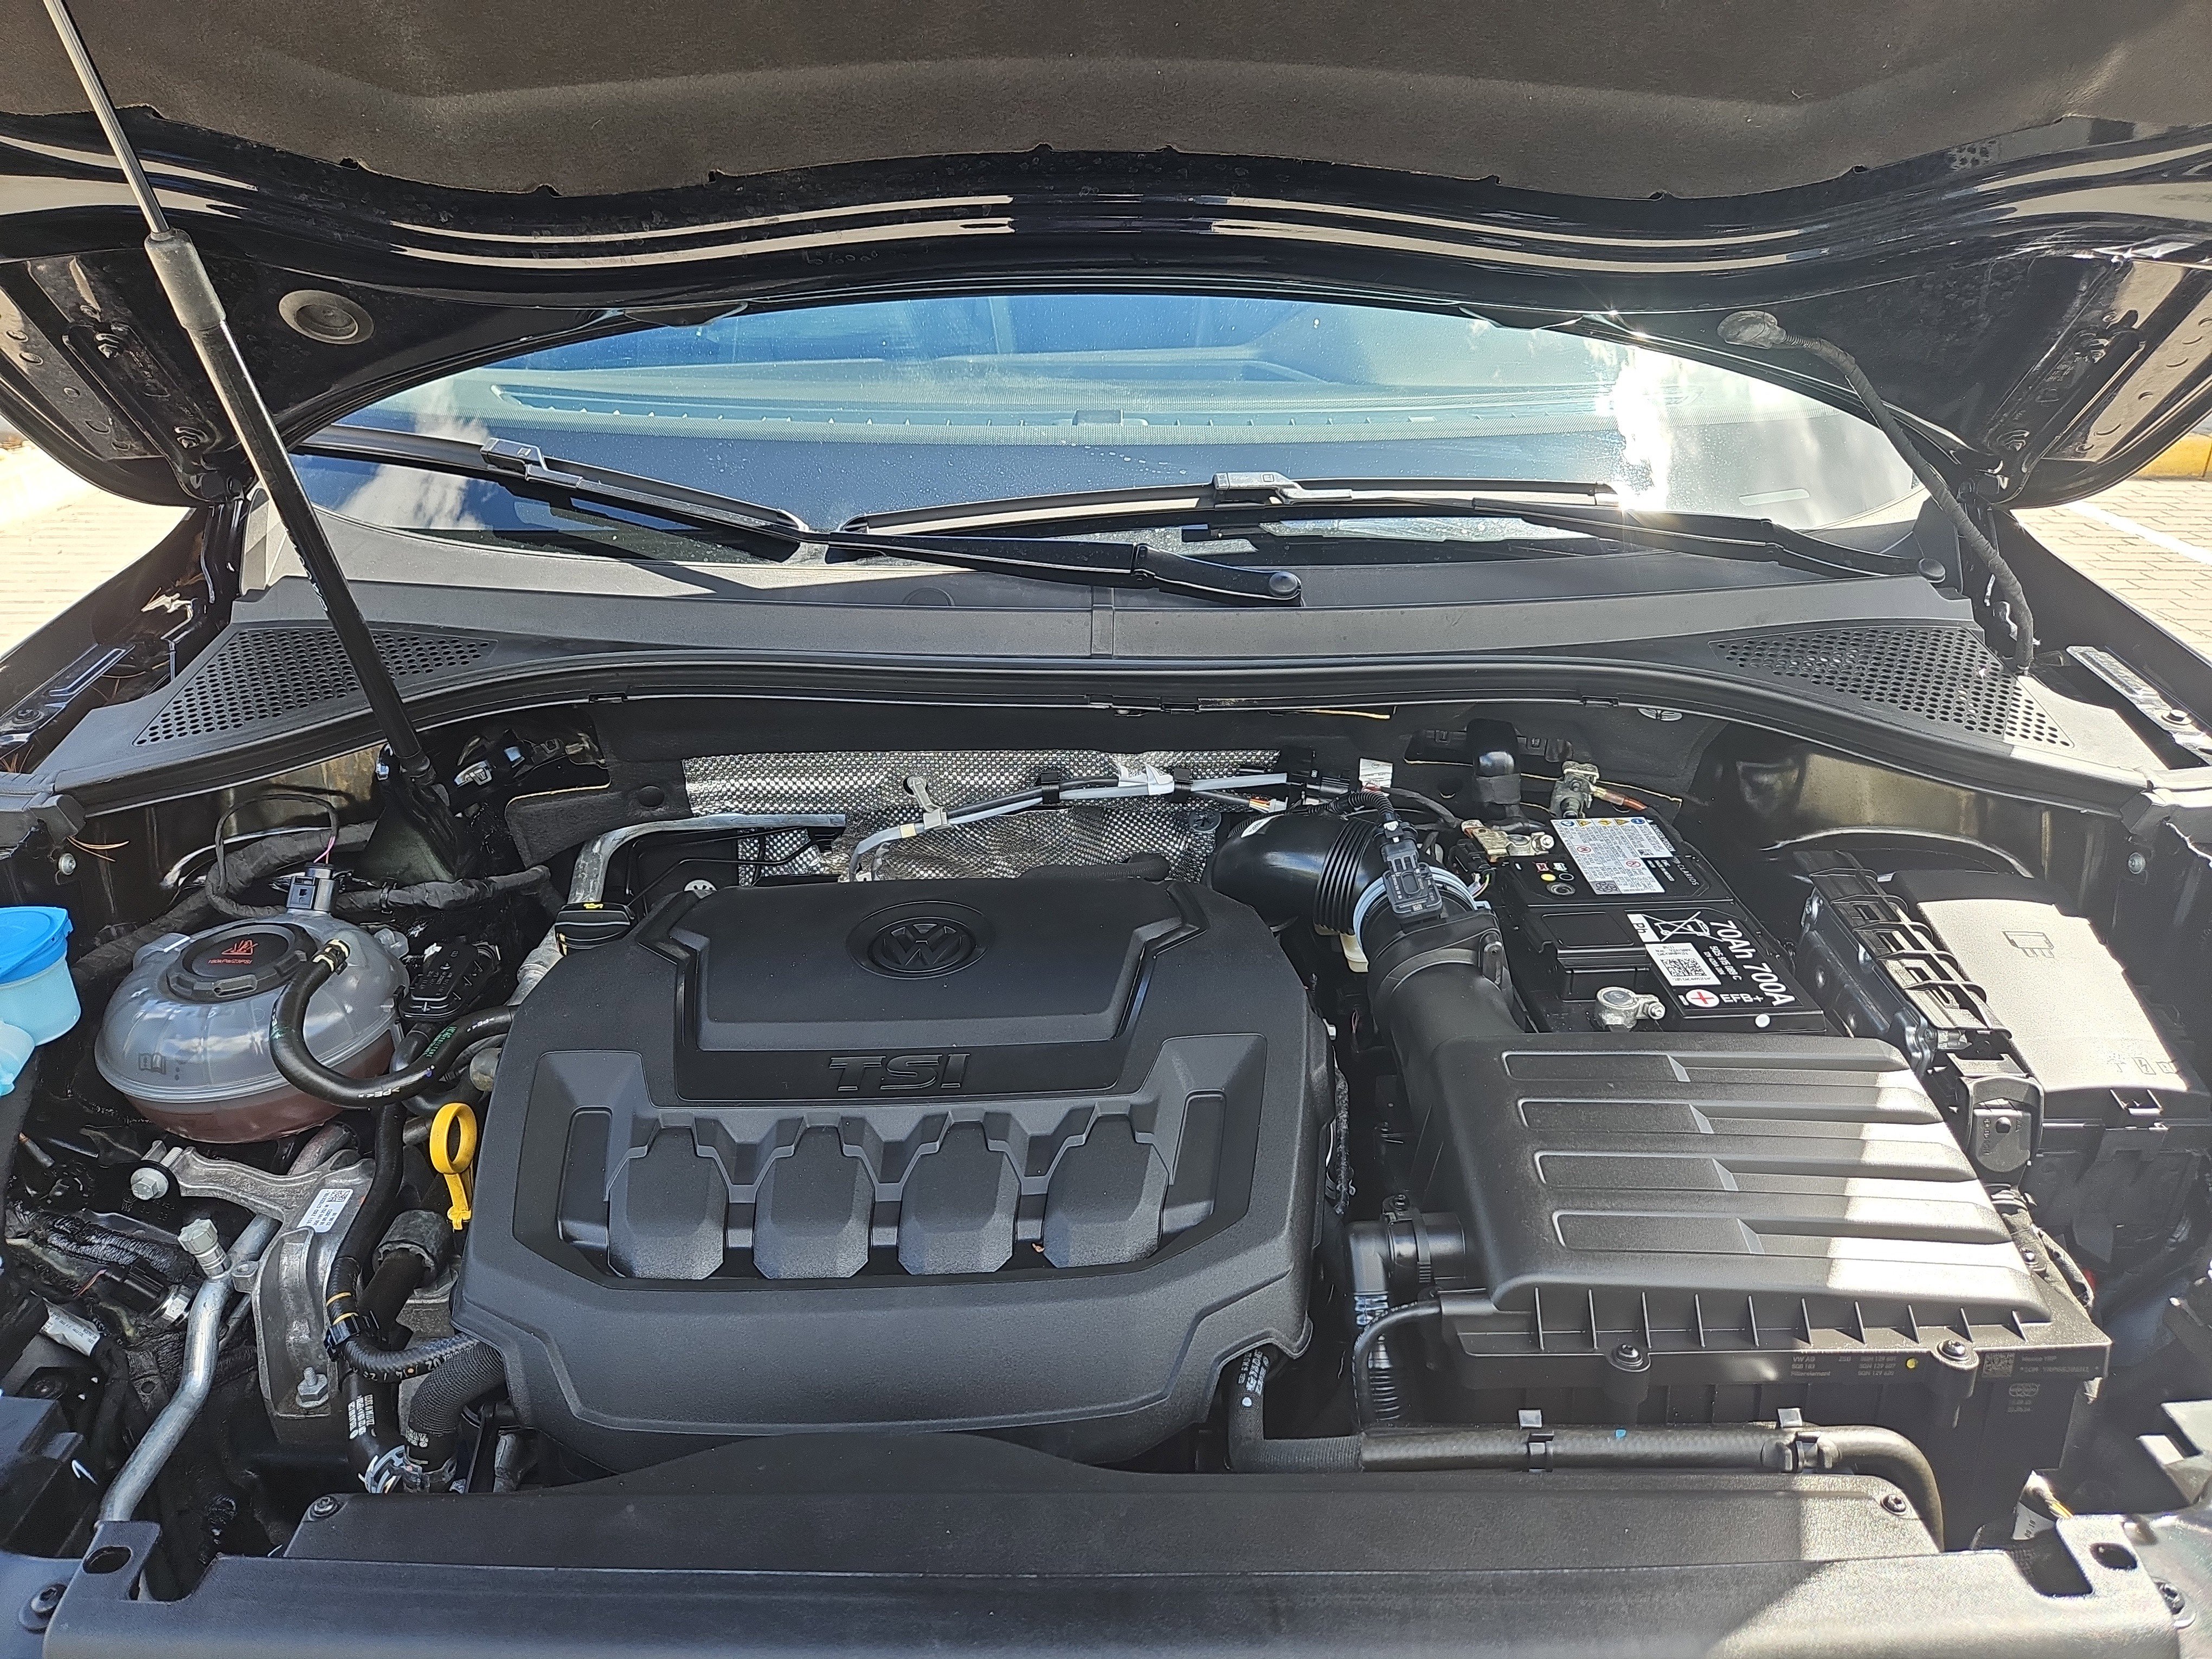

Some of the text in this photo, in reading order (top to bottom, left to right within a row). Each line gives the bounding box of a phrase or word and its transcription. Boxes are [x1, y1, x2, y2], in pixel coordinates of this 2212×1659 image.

[1677, 864, 1700, 885] CLARIOS
[1632, 923, 1648, 934] Pb
[1709, 920, 1795, 1006] 70Ah 700A
[829, 1053, 970, 1091] TSI
